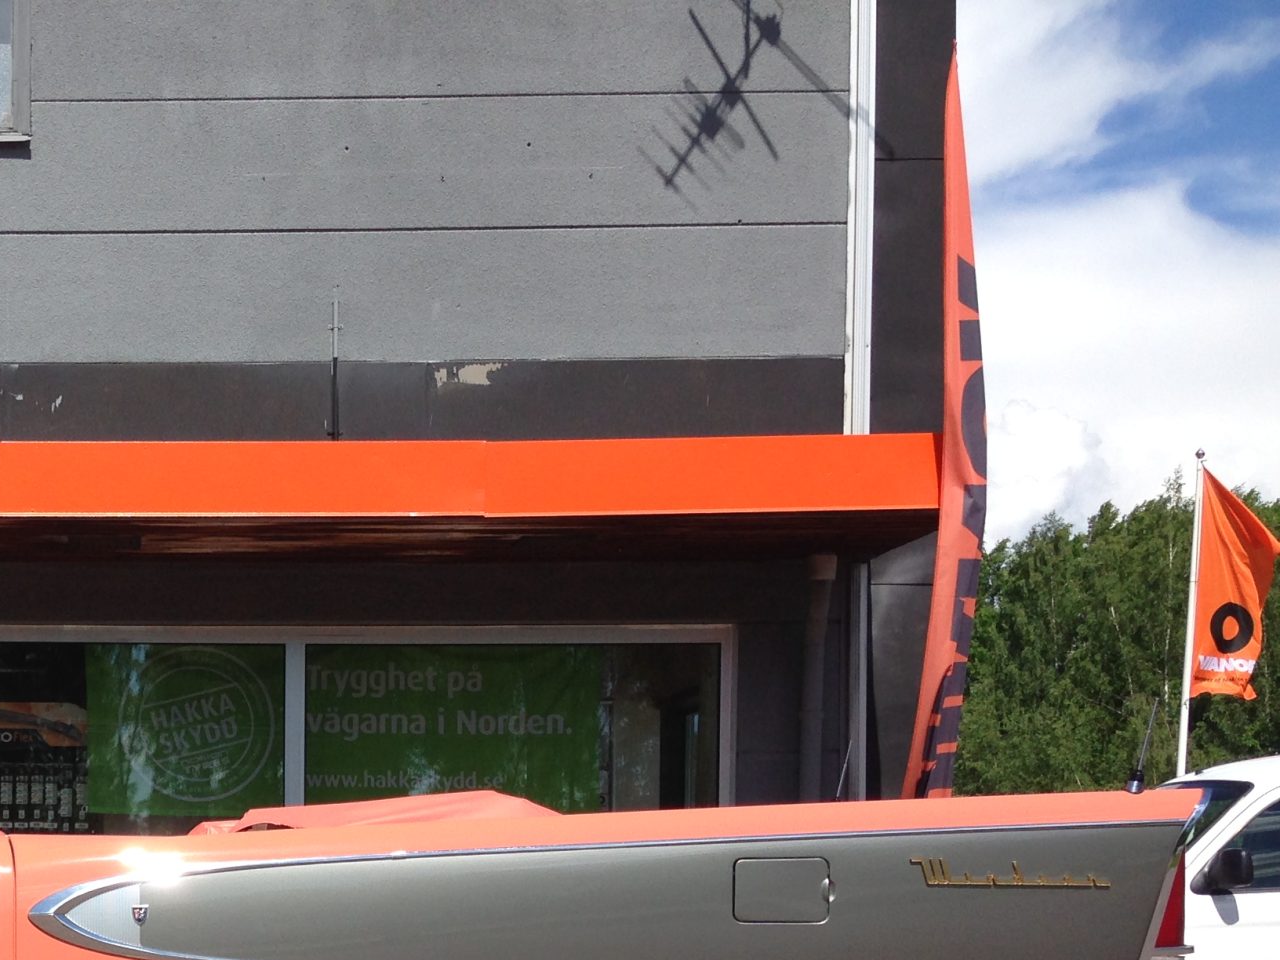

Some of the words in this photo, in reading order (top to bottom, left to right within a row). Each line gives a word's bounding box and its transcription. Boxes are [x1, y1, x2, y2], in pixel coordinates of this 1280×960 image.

[308, 662, 437, 698] Trygghet
[447, 663, 483, 698] på
[150, 693, 236, 730] HAKKA
[306, 707, 426, 742] vägarna
[437, 707, 445, 735] i
[457, 708, 572, 736] Norden.
[158, 716, 238, 754] SKYDD
